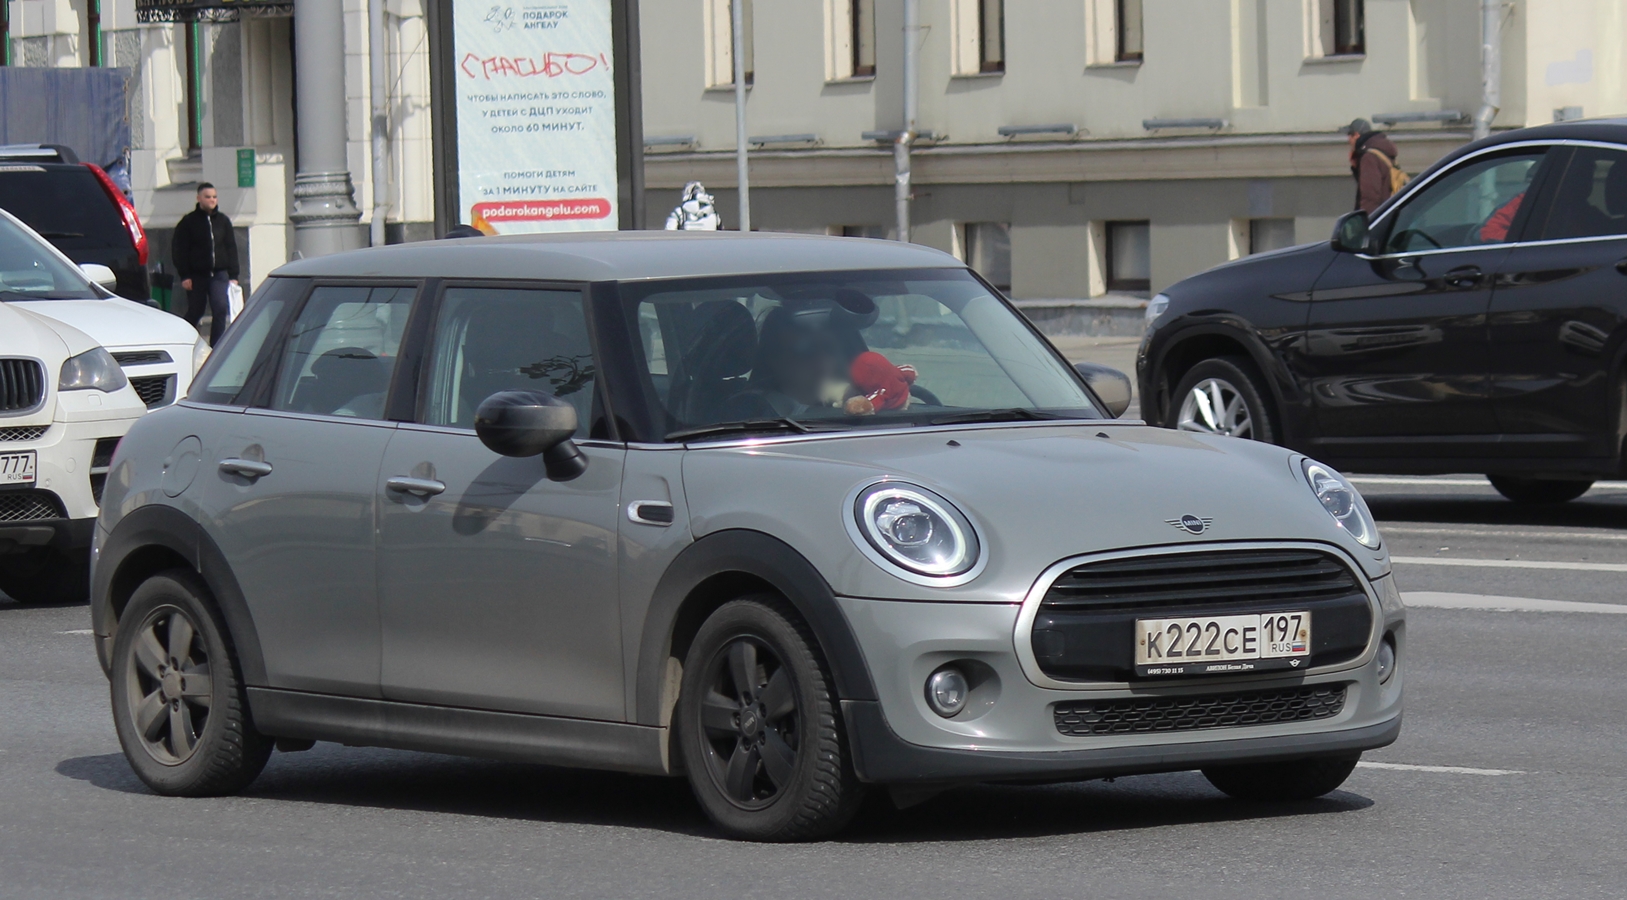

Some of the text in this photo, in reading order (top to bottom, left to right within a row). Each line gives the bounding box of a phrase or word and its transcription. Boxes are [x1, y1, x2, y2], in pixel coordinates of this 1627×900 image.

[523, 11, 568, 20] ПОДАРОК
[524, 21, 559, 30] АНГЕЛУ
[461, 52, 609, 80] СПАСИБО!
[467, 90, 607, 103] ЧТОБЫ НАПИСАТЬ ЭТО СЛОВО,
[482, 106, 593, 118] У ДЕТЕЙ С ДЦП УХОДИТ
[491, 121, 585, 134] ОКОЛО 60 МИНУТ.
[504, 170, 576, 180] ПОМОГИ ДЕТЯМ
[483, 187, 495, 196] ЗА
[503, 185, 551, 195] МИНУТУ
[553, 186, 566, 194] НА
[568, 183, 598, 193] САЙТЕ
[482, 204, 600, 219] podarokangelu.com
[1, 455, 30, 474] 777
[7, 473, 22, 481] RUS
[1263, 614, 1302, 643] 197
[1271, 643, 1292, 653] RUS
